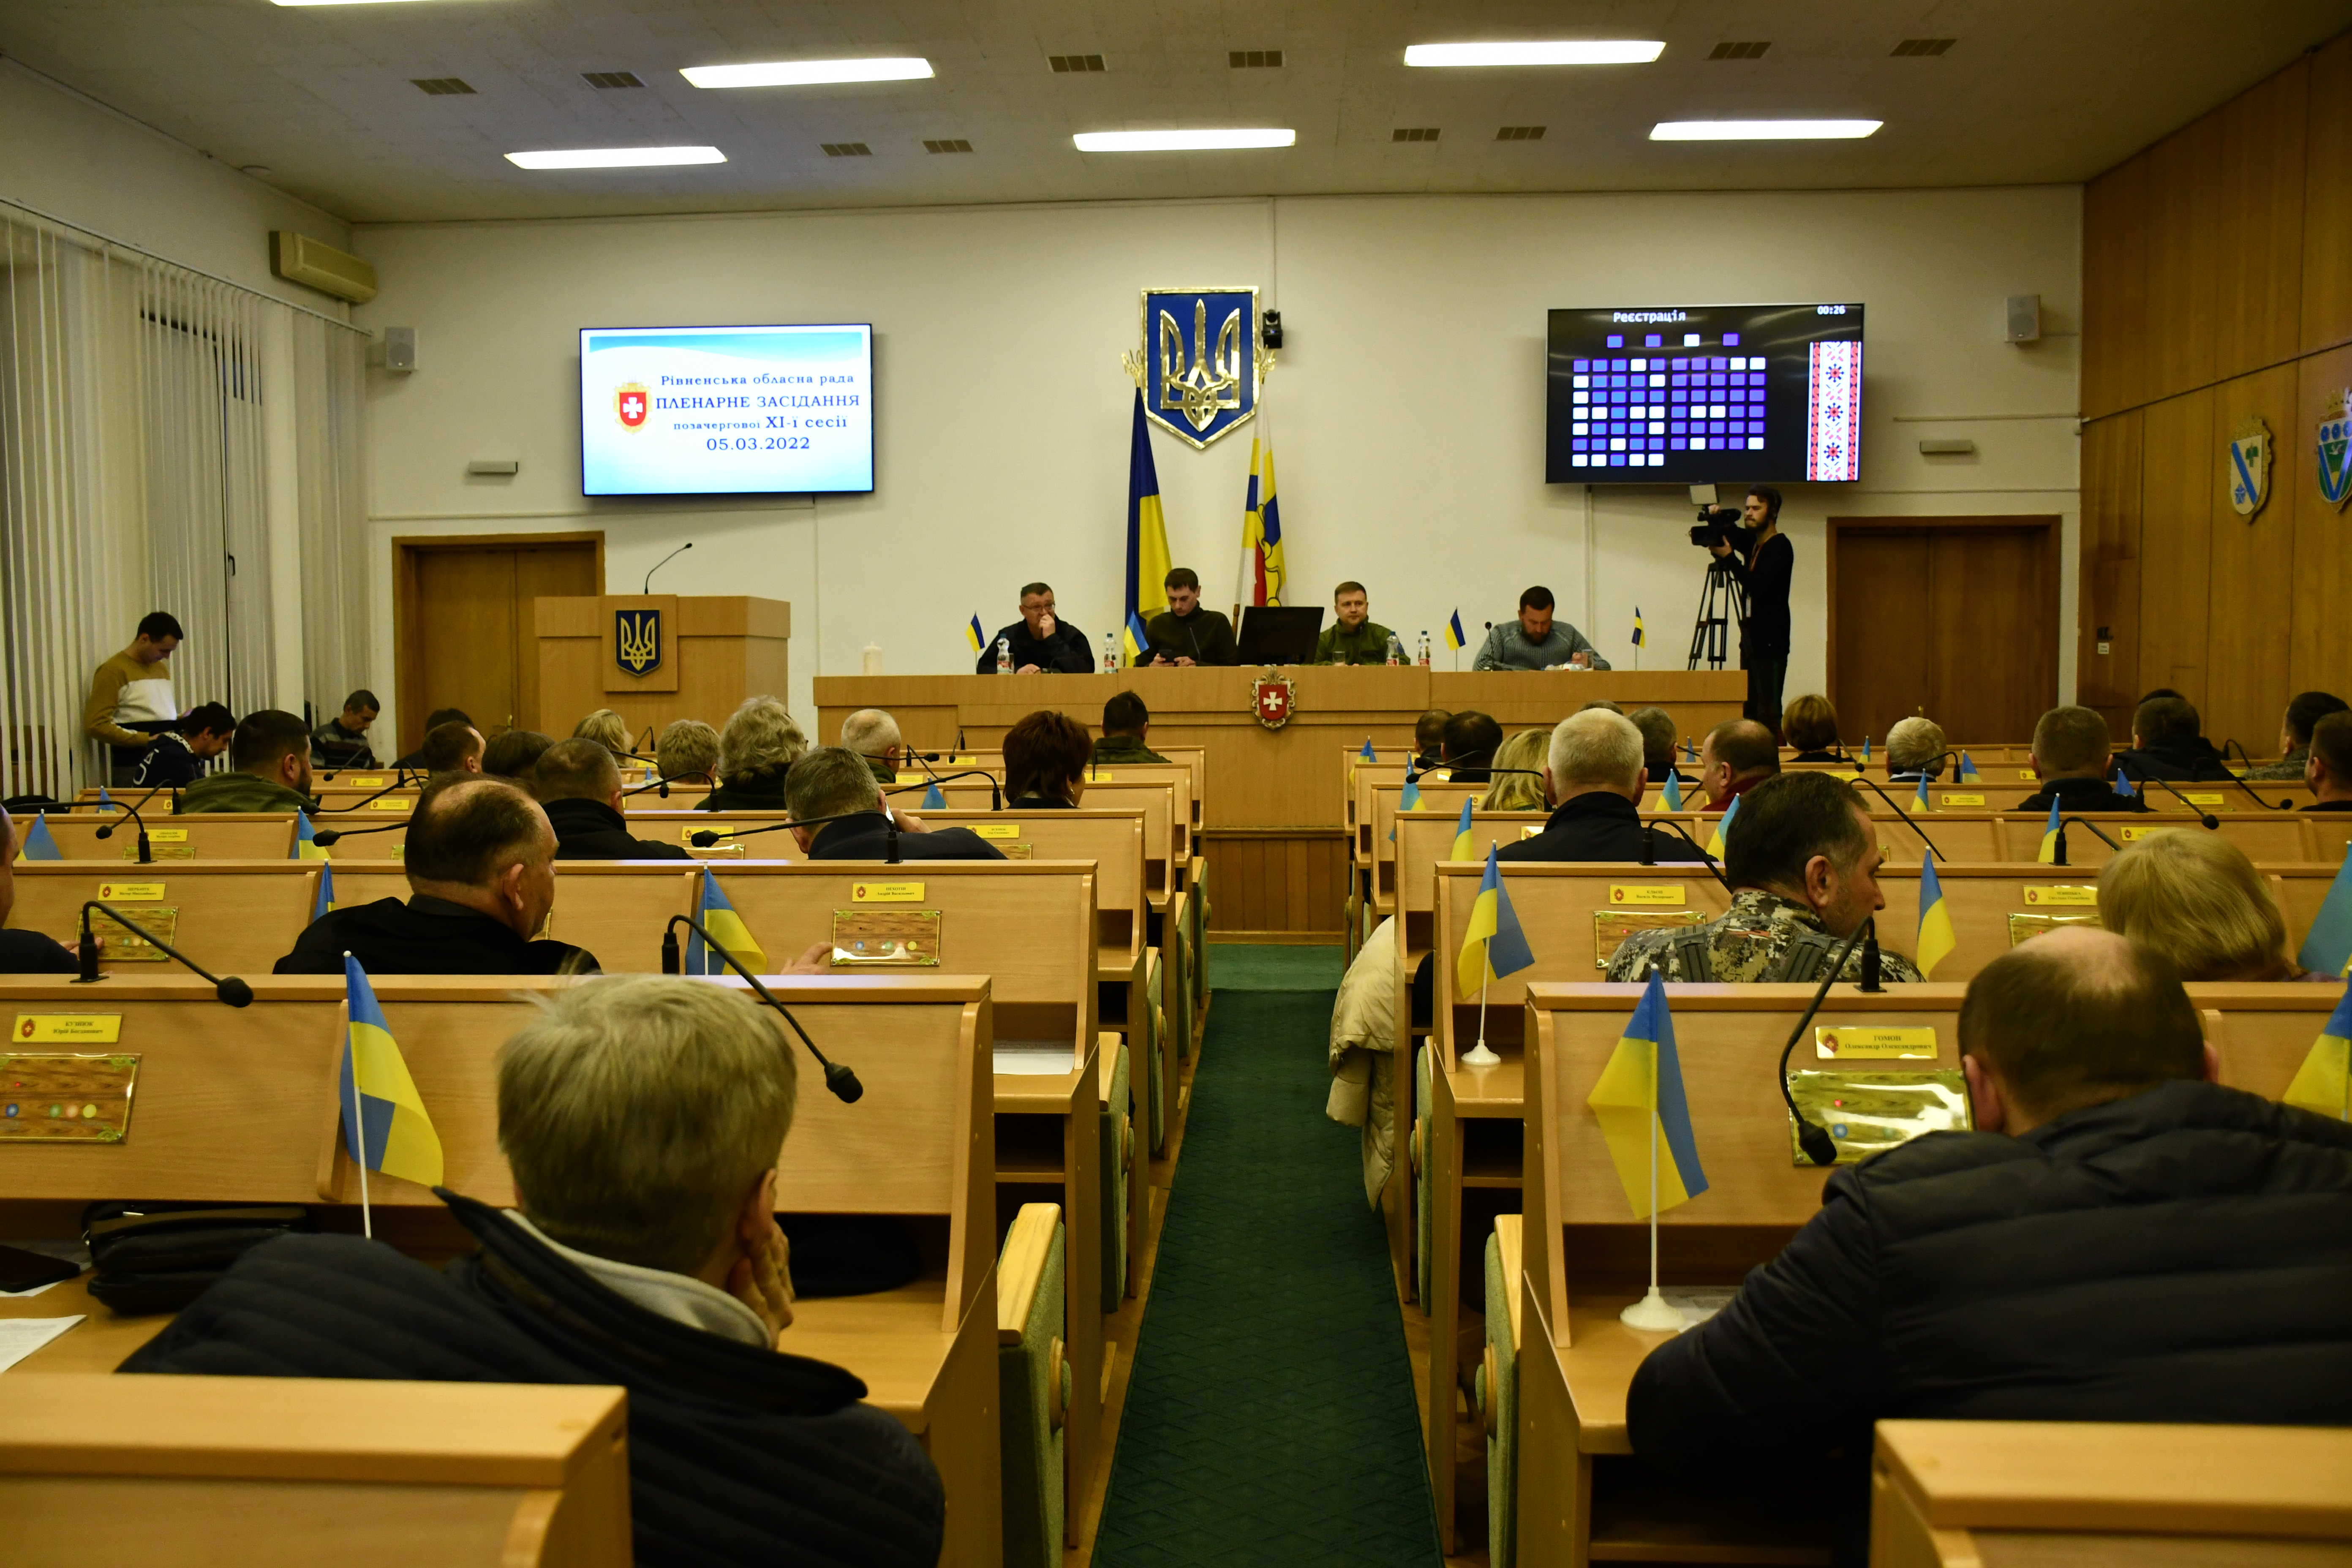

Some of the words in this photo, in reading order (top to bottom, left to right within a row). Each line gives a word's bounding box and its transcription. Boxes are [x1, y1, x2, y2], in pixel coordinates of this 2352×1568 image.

[1613, 309, 1687, 323] Реєстрація
[1817, 305, 1846, 315] 00:26
[661, 375, 747, 386] Рівненська
[753, 373, 813, 384] обласна
[820, 374, 854, 385] рада
[656, 397, 750, 409] ПЛЕНАРНЕ
[757, 395, 860, 408] ЗАСІДАННЯ
[673, 420, 760, 431] позачергової
[805, 415, 847, 428] сесії
[706, 437, 810, 450] 05.03.2022
